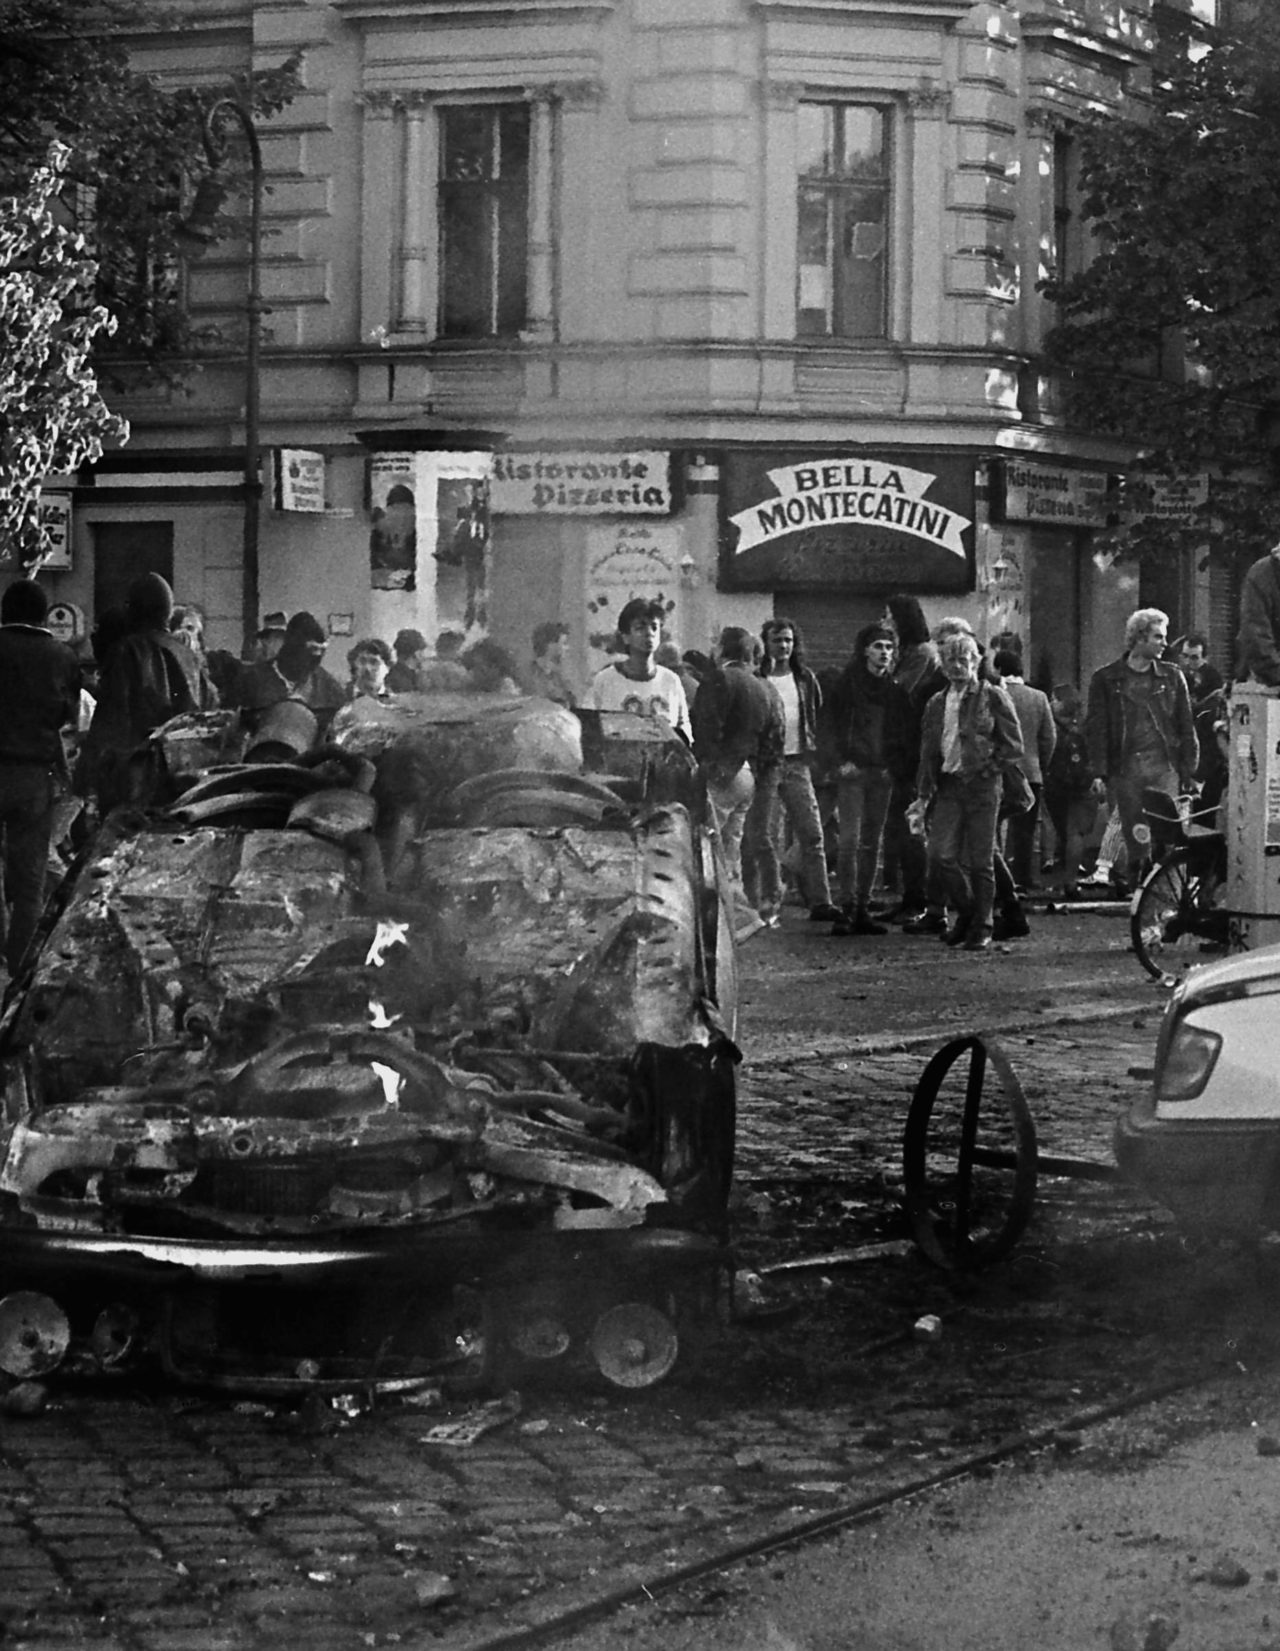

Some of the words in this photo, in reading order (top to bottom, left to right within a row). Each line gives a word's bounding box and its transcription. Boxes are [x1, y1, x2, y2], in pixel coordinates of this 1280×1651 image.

[794, 465, 906, 494] BELLA
[532, 483, 665, 509] Pizzeria
[757, 491, 951, 540] MONTECATINI
